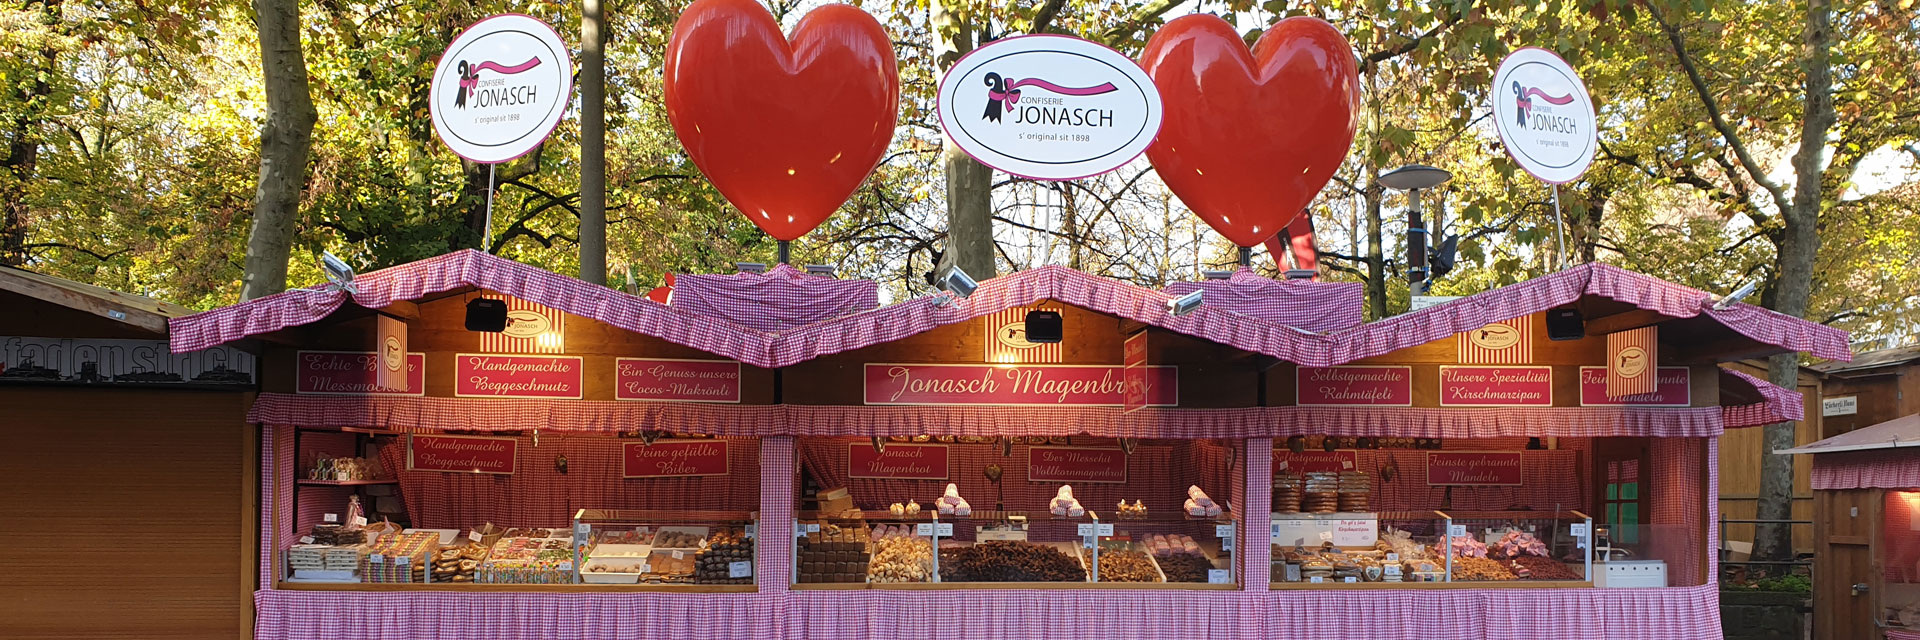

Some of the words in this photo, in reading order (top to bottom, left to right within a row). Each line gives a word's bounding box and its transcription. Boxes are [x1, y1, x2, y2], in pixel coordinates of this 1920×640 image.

[478, 78, 505, 88] CONFISERIE
[474, 85, 537, 109] JONASCH
[1021, 97, 1064, 106] CONFISERIE
[480, 115, 499, 125] original
[507, 113, 520, 122] 1898
[1015, 106, 1113, 128] JONASCH
[1532, 113, 1577, 135] JONASCH
[1027, 132, 1058, 142] original
[1059, 133, 1069, 141] sit
[1071, 134, 1090, 142] 1898
[305, 354, 352, 371] Echte
[469, 357, 571, 376] Handgemachte
[618, 364, 644, 377] Ein
[647, 365, 697, 381] Genuss
[699, 370, 737, 379] unsere
[1310, 368, 1403, 386] Selbstgemachte
[1441, 368, 1487, 383] Unsere
[1489, 369, 1550, 387] Spezialität
[470, 376, 571, 395] Beggeschmutz
[888, 366, 1001, 402] Jonasch
[1319, 386, 1394, 404] Rahmtäfeli
[1449, 386, 1543, 403] Kirschmarzipan
[421, 437, 505, 454] Handgemachte
[634, 444, 669, 458] Feine
[671, 443, 720, 461] gefüllte
[421, 453, 505, 469] Beggeschmutz
[1042, 451, 1064, 462] Der
[1429, 454, 1466, 467] Feinste
[1468, 455, 1519, 470] gebrannte
[656, 461, 698, 474] Biber
[867, 461, 932, 477] Magenbrot
[1031, 464, 1124, 479] Vollkornmagenbrot
[1448, 470, 1500, 482] Mandeln
